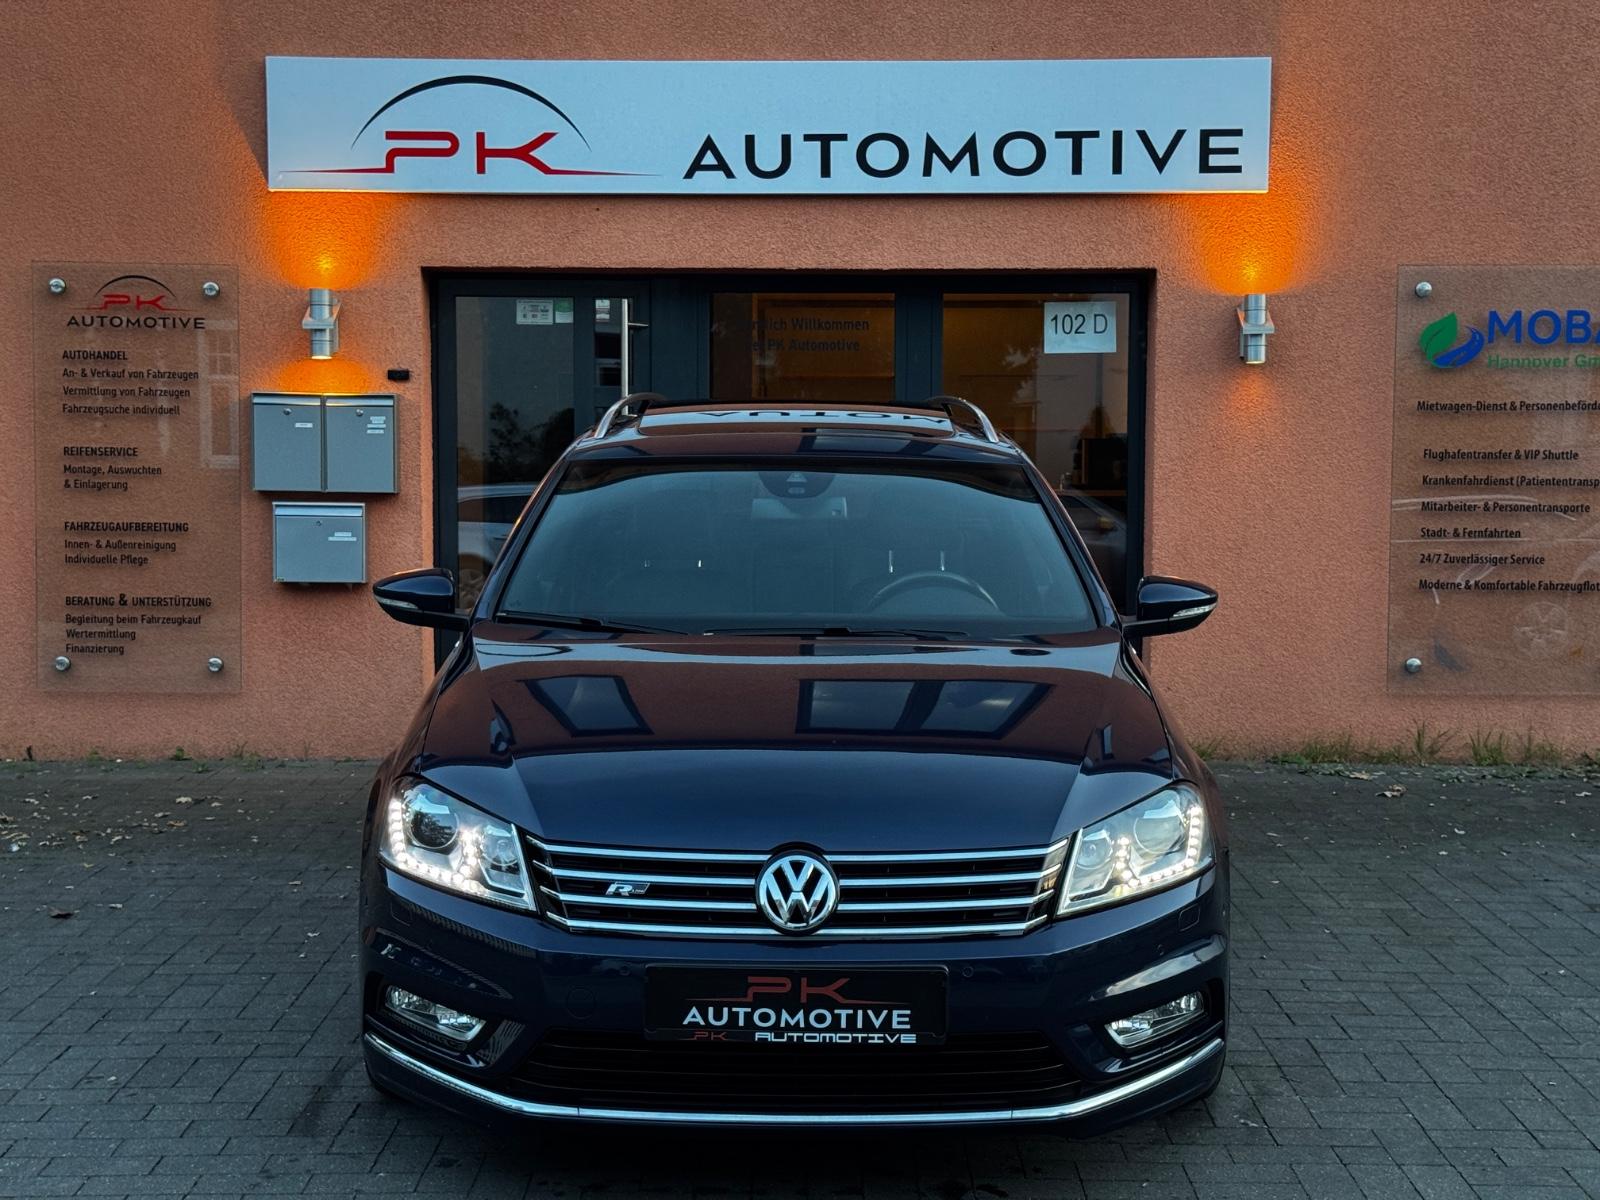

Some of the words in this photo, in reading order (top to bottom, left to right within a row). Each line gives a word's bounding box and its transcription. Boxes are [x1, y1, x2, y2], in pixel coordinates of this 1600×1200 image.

[385, 131, 559, 175] PK
[683, 128, 1243, 179] AUTOMOTIVE
[102, 294, 165, 311] PK
[66, 315, 206, 329] AUTOMOTIVE
[791, 318, 870, 331] Willkommen
[1051, 314, 1086, 334] 102
[1094, 314, 1108, 334] D
[1488, 309, 1600, 345] MOB
[789, 339, 860, 351] Automotive
[62, 350, 128, 361] AUTOHANDEL
[1488, 355, 1569, 369] Hannover
[81, 368, 88, 378] &
[90, 368, 126, 379] Verkauf
[128, 370, 144, 379] von
[146, 369, 199, 381] Fahrzeugen
[63, 386, 117, 398] Vermittlung
[119, 389, 136, 397] von
[138, 387, 190, 399] Fahrzeugen
[62, 403, 130, 416] Fahrzeugsuche
[132, 405, 180, 415] individuell
[1416, 400, 1507, 413] Mietwagen-Dienst
[1510, 401, 1517, 411] &
[63, 446, 138, 457] REIFENSERVICE
[1423, 448, 1512, 461] Flughafentransfer
[1514, 450, 1522, 460] &
[1524, 450, 1540, 460] VIP
[1542, 449, 1579, 461] Shuttle
[63, 465, 105, 476] Montage,
[107, 465, 162, 475] Auswuchten
[64, 479, 71, 489] &
[74, 479, 128, 491] Einlagerung
[1422, 475, 1514, 486] Krankenfahrdienst
[1421, 501, 1481, 512] Mitarbeiter-
[1483, 502, 1490, 512] &
[1493, 501, 1591, 515] Personentransporte
[64, 521, 189, 533] FAHRZEUGAUFBEREITUNG
[1453, 528, 1460, 538] &
[1463, 527, 1521, 539] Fernfahrten
[96, 540, 103, 549] &
[105, 540, 177, 552] Außenreinigung
[65, 554, 118, 564] Individuelle
[120, 554, 149, 566] Pflege
[1419, 553, 1441, 564] 24/7
[1443, 553, 1508, 566] Zuverlässiger
[1510, 554, 1545, 564] Service
[1419, 579, 1462, 590] Moderne
[1464, 580, 1472, 590] &
[1474, 579, 1536, 591] Komfortable
[65, 596, 115, 607] BERATUNG
[118, 593, 128, 607] &
[132, 594, 212, 608] UNTERSTÜTZUNG
[65, 614, 114, 626] Begleitung
[116, 614, 138, 624] beim
[141, 614, 201, 627] Fahrzeugkauf
[66, 629, 136, 640] Wertermittlung
[66, 644, 124, 656] Finanzierung
[747, 976, 850, 1003] PK
[682, 1006, 912, 1029] AUTOMOTIVE
[693, 1031, 727, 1041] PK
[755, 1031, 917, 1043] AUTOMOTIVE
